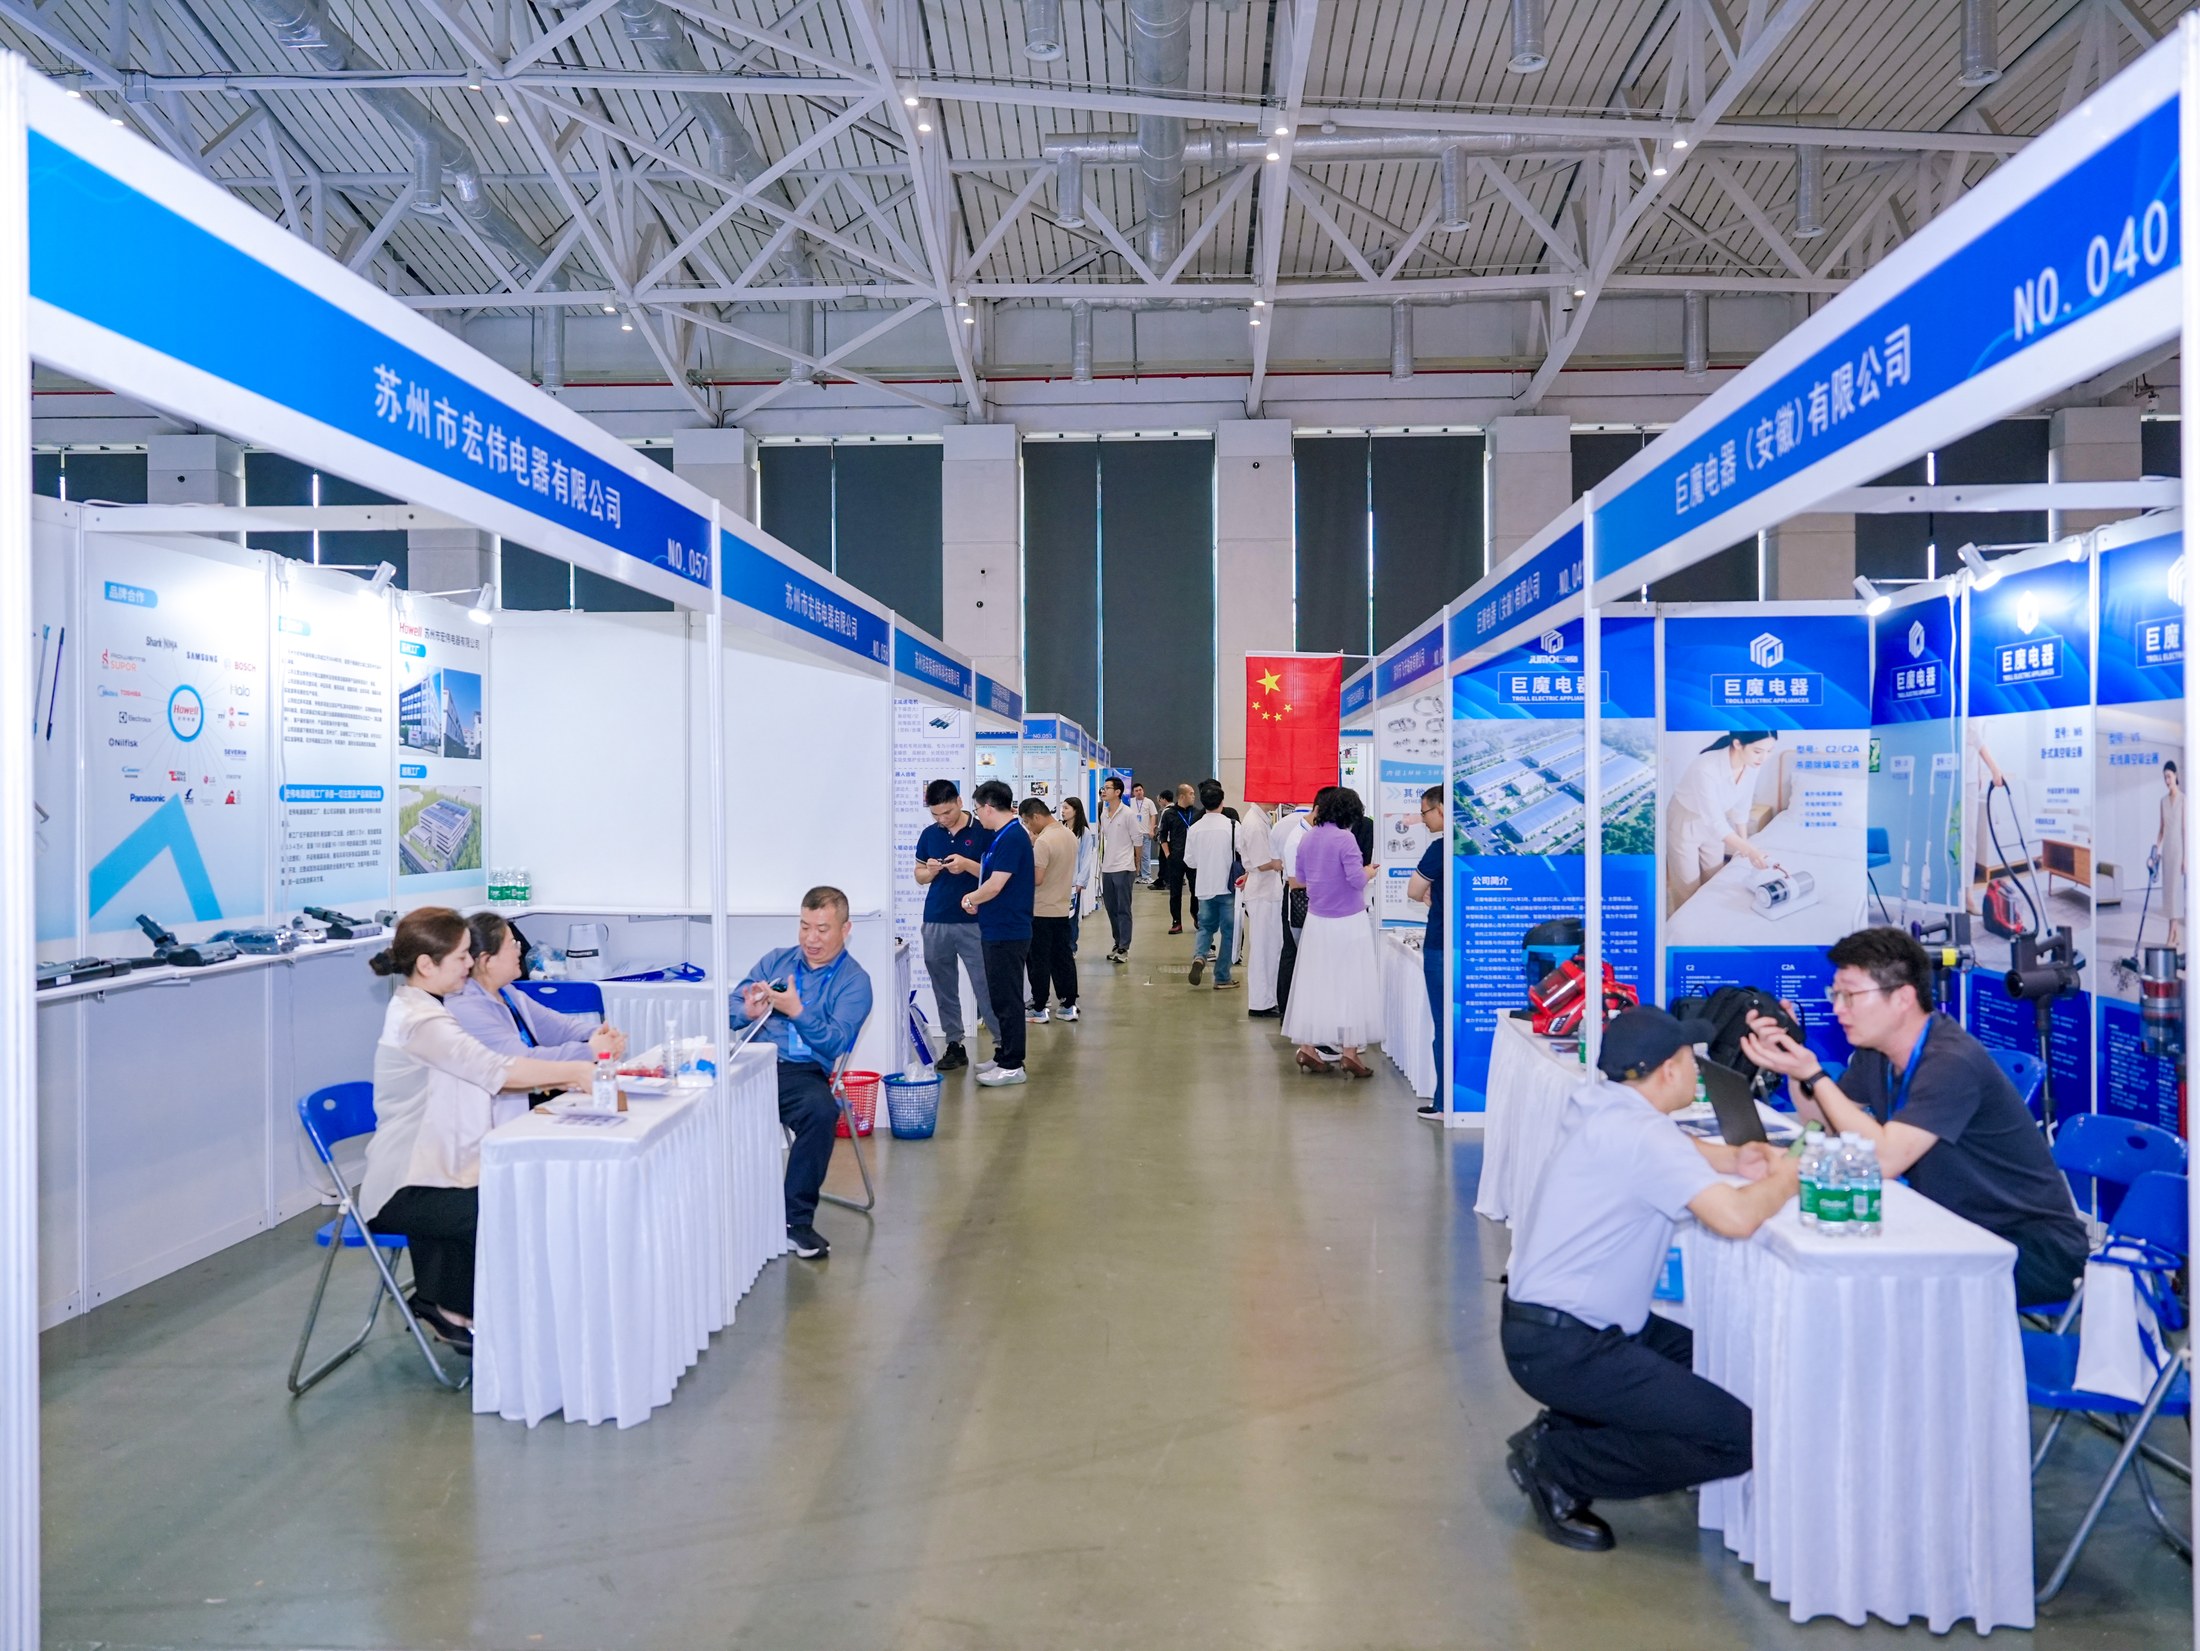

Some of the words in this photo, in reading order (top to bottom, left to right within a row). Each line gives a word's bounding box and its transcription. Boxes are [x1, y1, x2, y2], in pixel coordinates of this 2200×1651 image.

[374, 363, 622, 529] 苏州市宏伟电器有限公司
[109, 585, 145, 603] 品牌合作
[784, 581, 858, 640] 苏州市宏伟电器有限公司
[2146, 623, 2180, 651] 巨魔
[186, 651, 218, 663] SAMSUNG
[234, 661, 257, 671] BOSCH
[2002, 643, 2054, 672] 巨魔电器
[1896, 666, 1936, 690] 巨魔电器
[1724, 678, 1810, 697] 巨魔电器
[173, 704, 199, 716] Howell
[129, 793, 166, 803] Panasonic
[1472, 876, 1509, 886] 公司简介
[1685, 964, 1696, 972] C2
